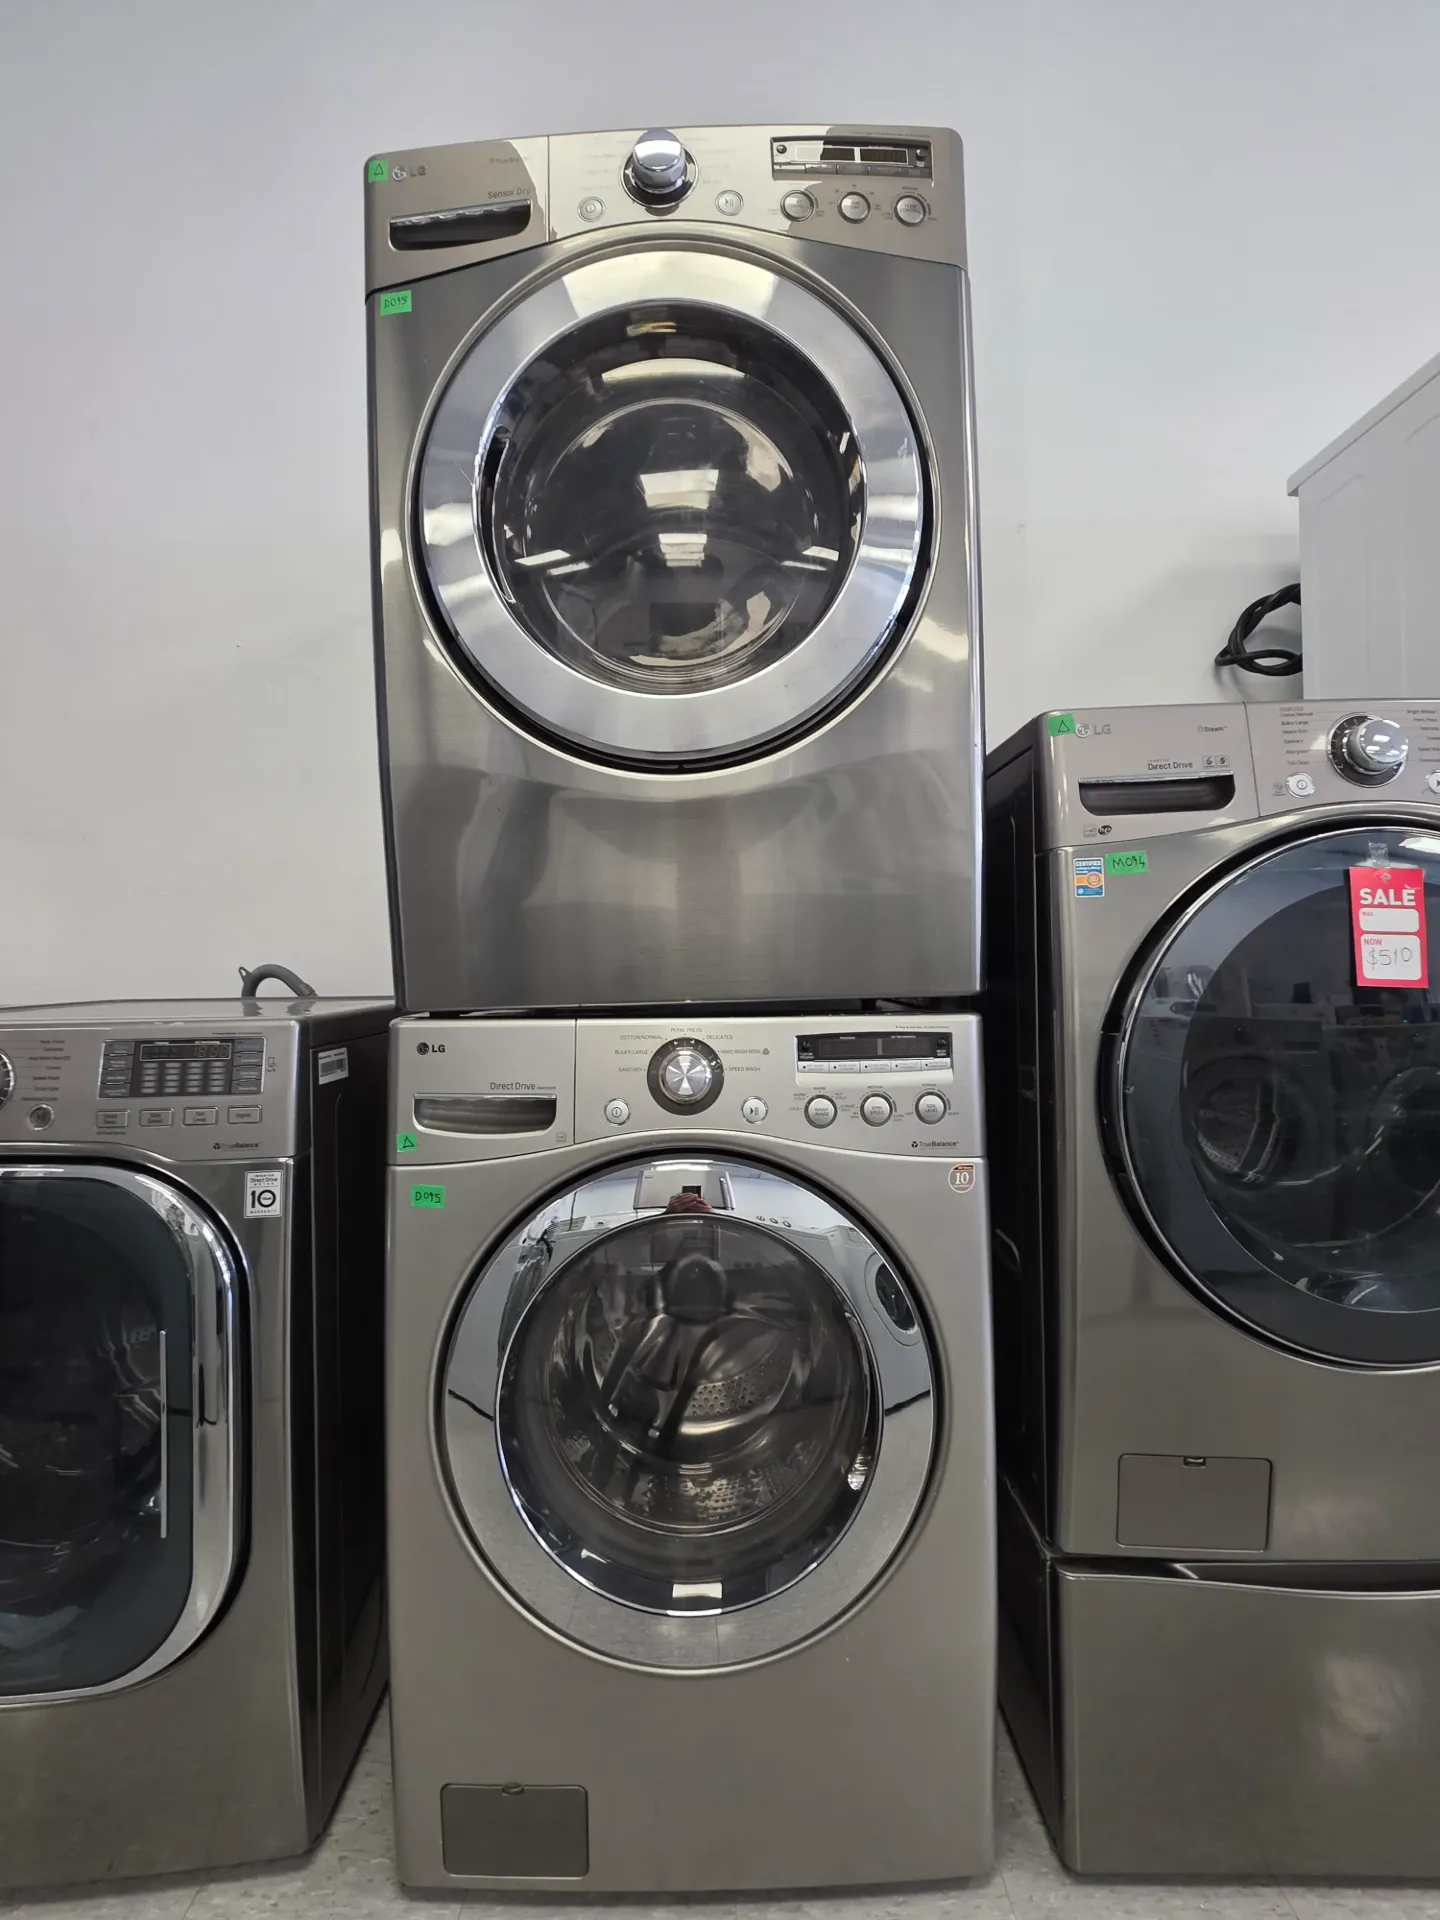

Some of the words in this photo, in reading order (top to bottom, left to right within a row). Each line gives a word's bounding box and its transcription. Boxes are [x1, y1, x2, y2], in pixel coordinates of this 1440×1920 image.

[410, 165, 426, 177] LG
[487, 189, 515, 199] Sensor
[516, 187, 530, 197] Dry
[1094, 724, 1111, 735] LG
[1147, 762, 1171, 771] Direct
[1173, 761, 1193, 769] Drive
[1112, 856, 1145, 869] M094
[1359, 888, 1417, 906] SALE
[1363, 938, 1383, 946] NOW
[1366, 946, 1413, 971] $510
[431, 1044, 446, 1053] LG
[490, 1081, 514, 1090] Direct
[515, 1081, 536, 1090] Drive
[955, 1172, 970, 1184] 10
[251, 1189, 276, 1208] 10
